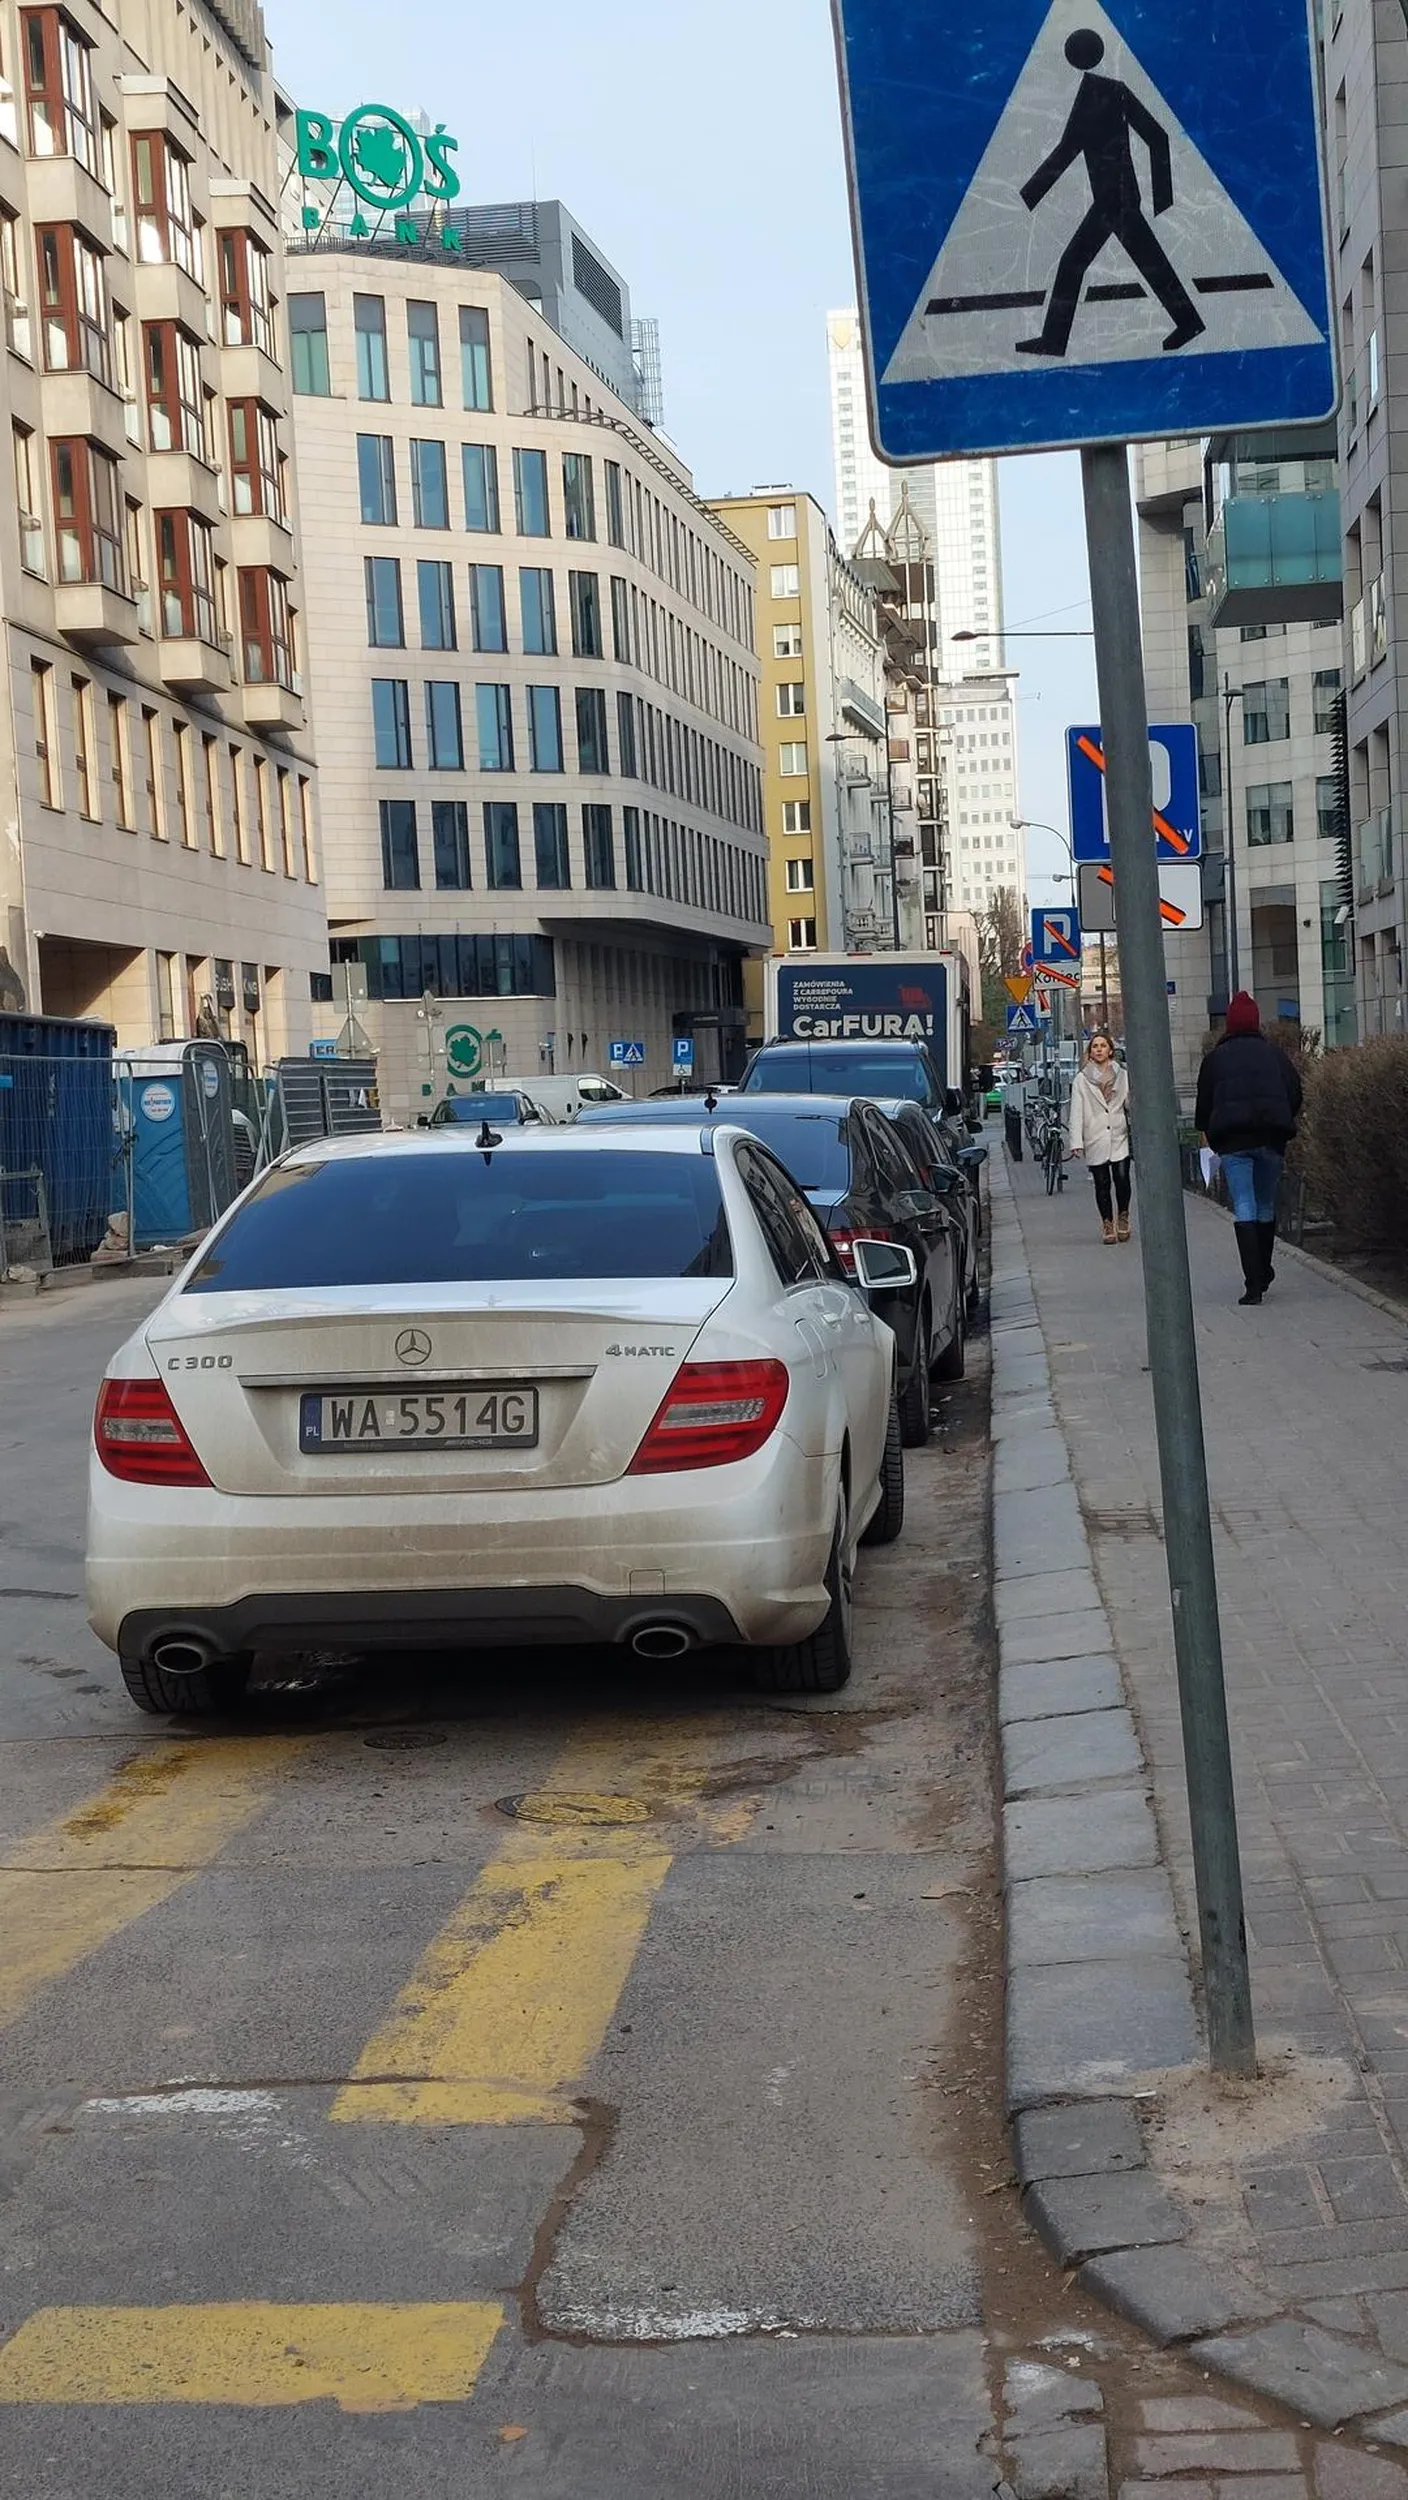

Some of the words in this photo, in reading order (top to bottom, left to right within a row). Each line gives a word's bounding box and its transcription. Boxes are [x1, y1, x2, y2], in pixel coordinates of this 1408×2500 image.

[296, 104, 460, 210] BOŚ
[301, 206, 463, 252] BANK
[793, 980, 845, 988] ZAMÓWIENIA
[1034, 970, 1080, 984] Koec
[793, 1003, 841, 1011] DOSTARCZA
[793, 1014, 934, 1037] CarFURA!
[613, 1043, 623, 1059] P
[677, 1041, 689, 1057] P
[605, 1344, 675, 1357] 4MATIC
[185, 1355, 233, 1370] 300
[305, 1426, 320, 1437] PL
[331, 1399, 381, 1438] WA
[399, 1395, 525, 1436] 5514G
